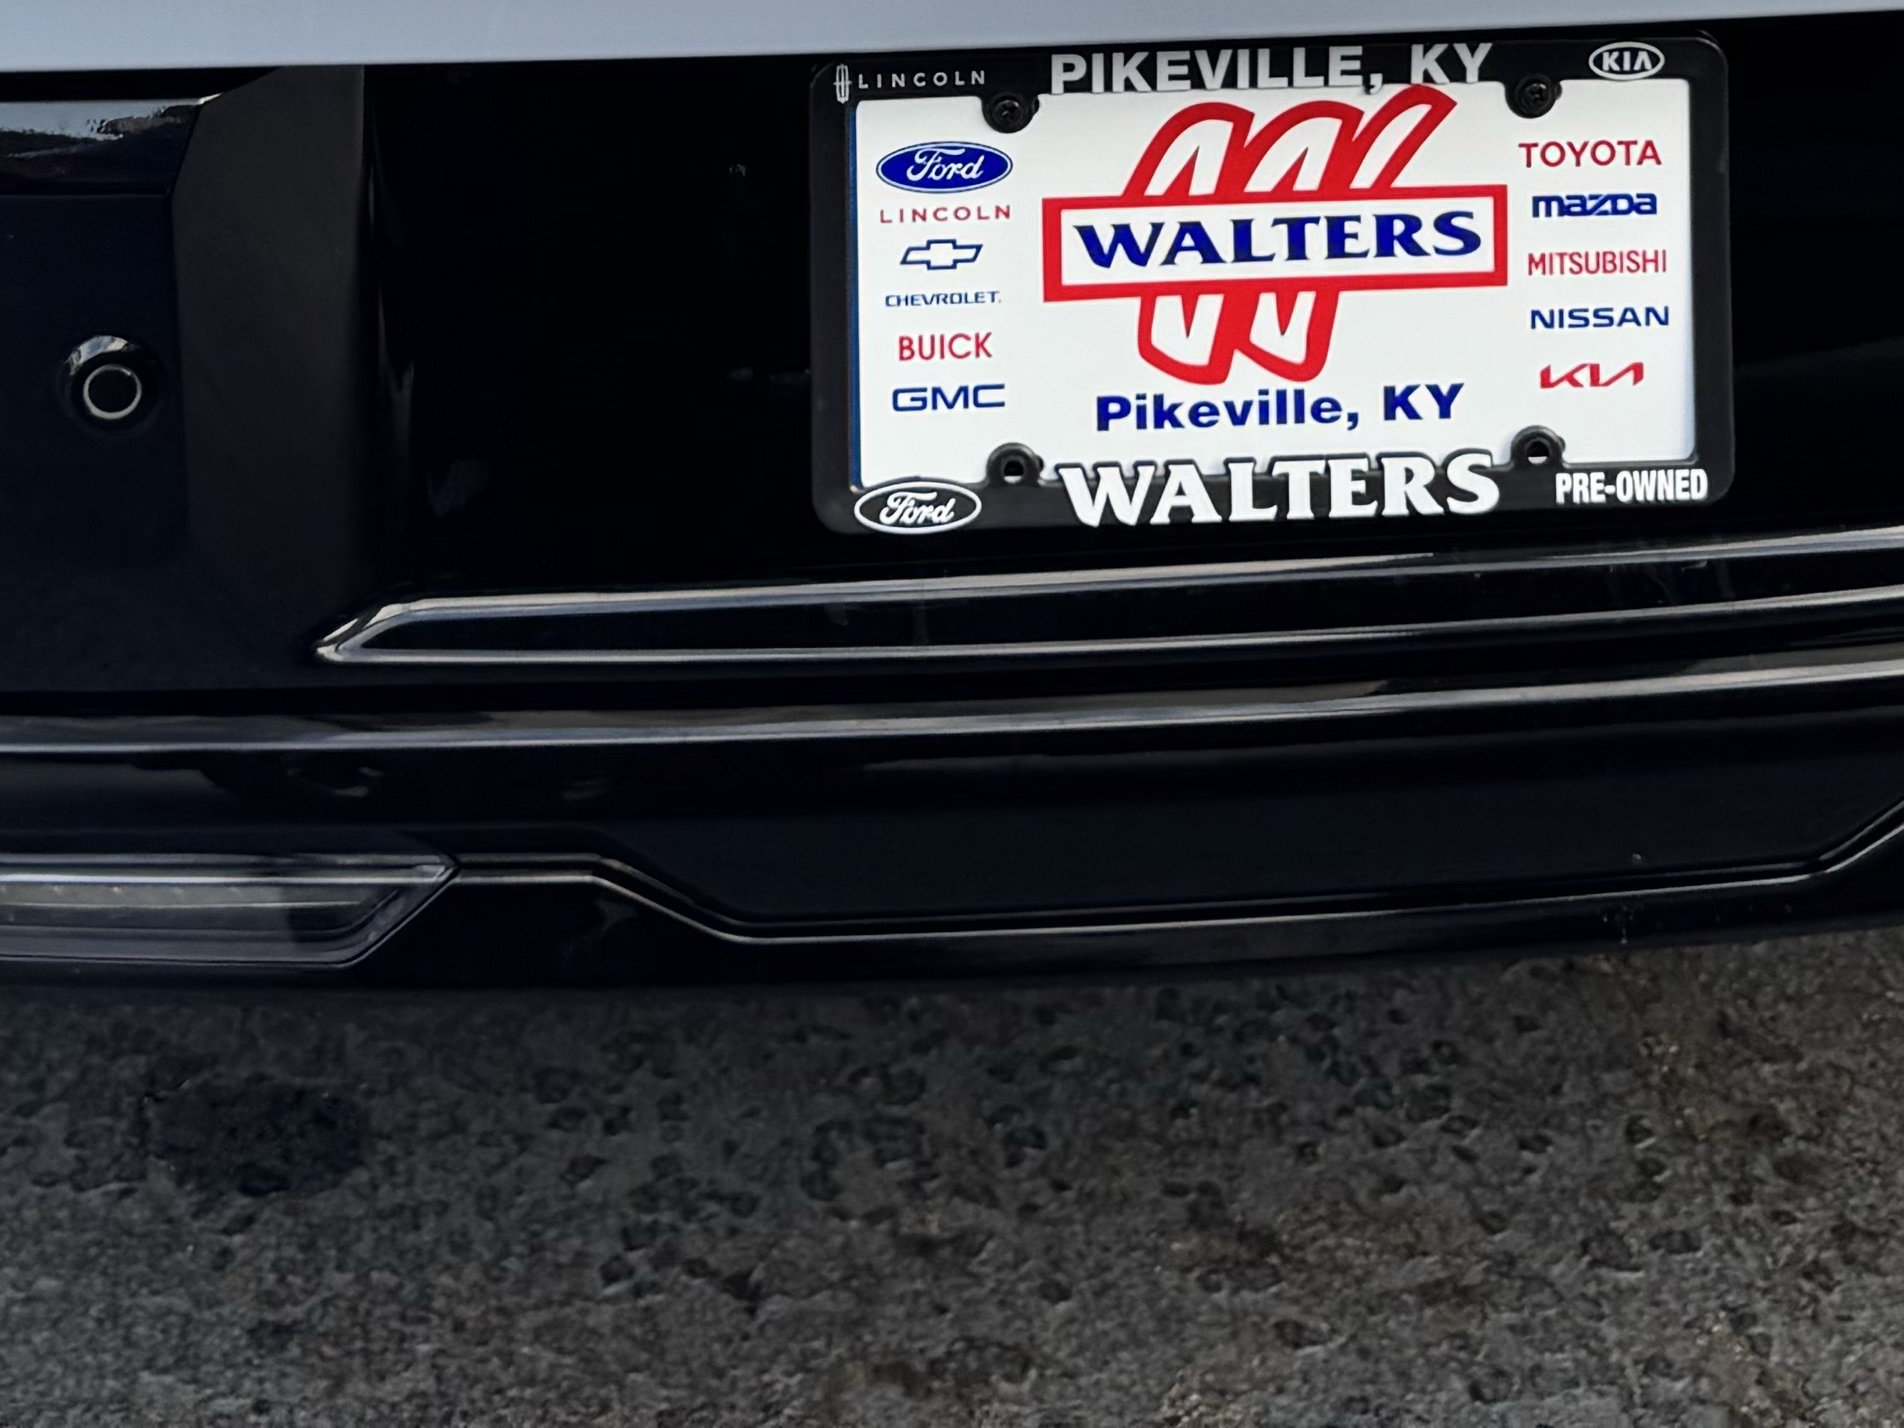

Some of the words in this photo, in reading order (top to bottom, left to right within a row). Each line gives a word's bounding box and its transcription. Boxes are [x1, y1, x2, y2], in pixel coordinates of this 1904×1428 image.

[1050, 45, 1384, 96] PIKEVILLE,
[1410, 42, 1493, 86] KY
[1601, 50, 1653, 72] KIA
[858, 69, 986, 90] LINCOLN
[906, 145, 985, 182] Ford
[1518, 140, 1663, 168] TOYOTA
[880, 204, 1011, 224] LINCOLN
[1073, 210, 1482, 270] WALTERS
[1528, 249, 1667, 276] MITSUBISHI
[1530, 305, 1670, 330] NISSAN
[898, 332, 993, 362] BUICK
[1539, 362, 1645, 389] KIA
[892, 383, 1006, 412] GMC
[1095, 387, 1360, 431] Pikeville,
[1383, 382, 1465, 422] KY
[1055, 450, 1501, 528] WALTERS
[1554, 468, 1709, 505] PRE-OWNED
[879, 490, 957, 525] Ford
